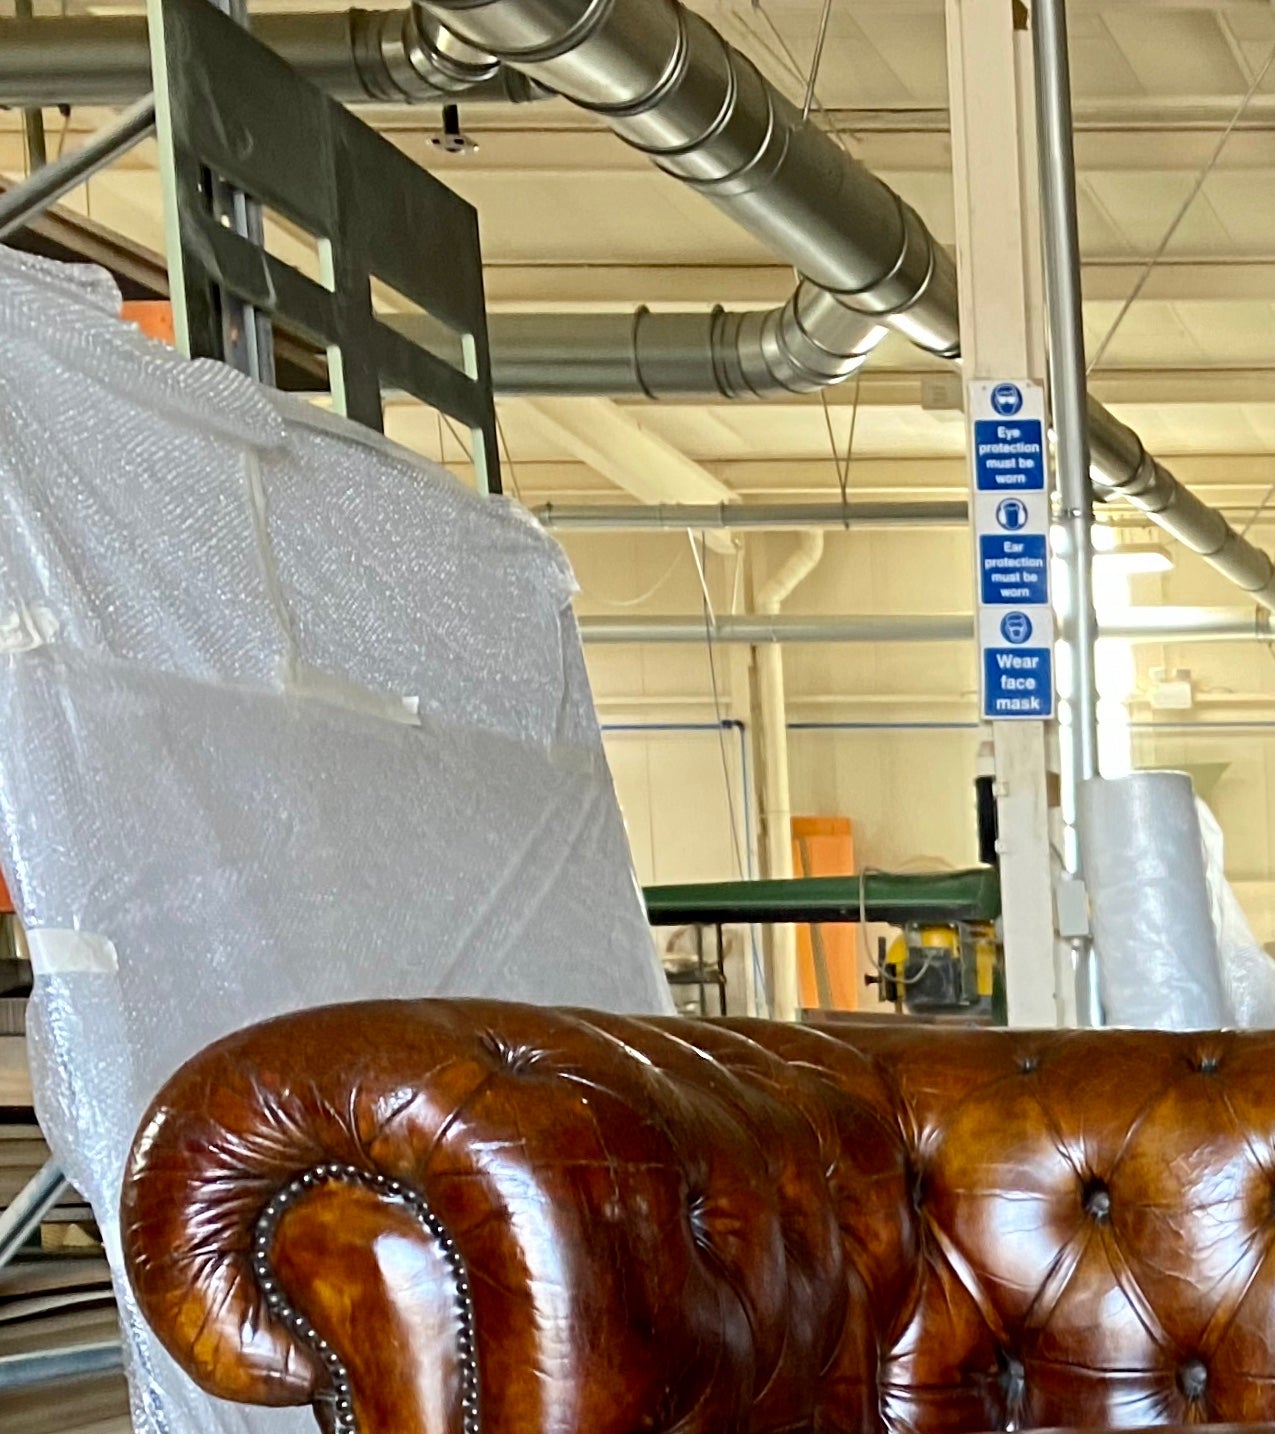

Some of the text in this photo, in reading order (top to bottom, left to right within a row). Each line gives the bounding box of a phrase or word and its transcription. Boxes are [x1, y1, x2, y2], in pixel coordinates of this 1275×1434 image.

[997, 425, 1021, 441] Eye
[979, 442, 1040, 456] protection
[986, 457, 1035, 469] must be
[995, 474, 1026, 484] worn
[1003, 541, 1024, 553] Ear
[984, 556, 1043, 571] protection
[991, 570, 1038, 583] must be
[1000, 588, 1030, 598] worn
[996, 653, 1039, 669] Wear
[1001, 674, 1036, 690] face
[996, 695, 1040, 710] mask
